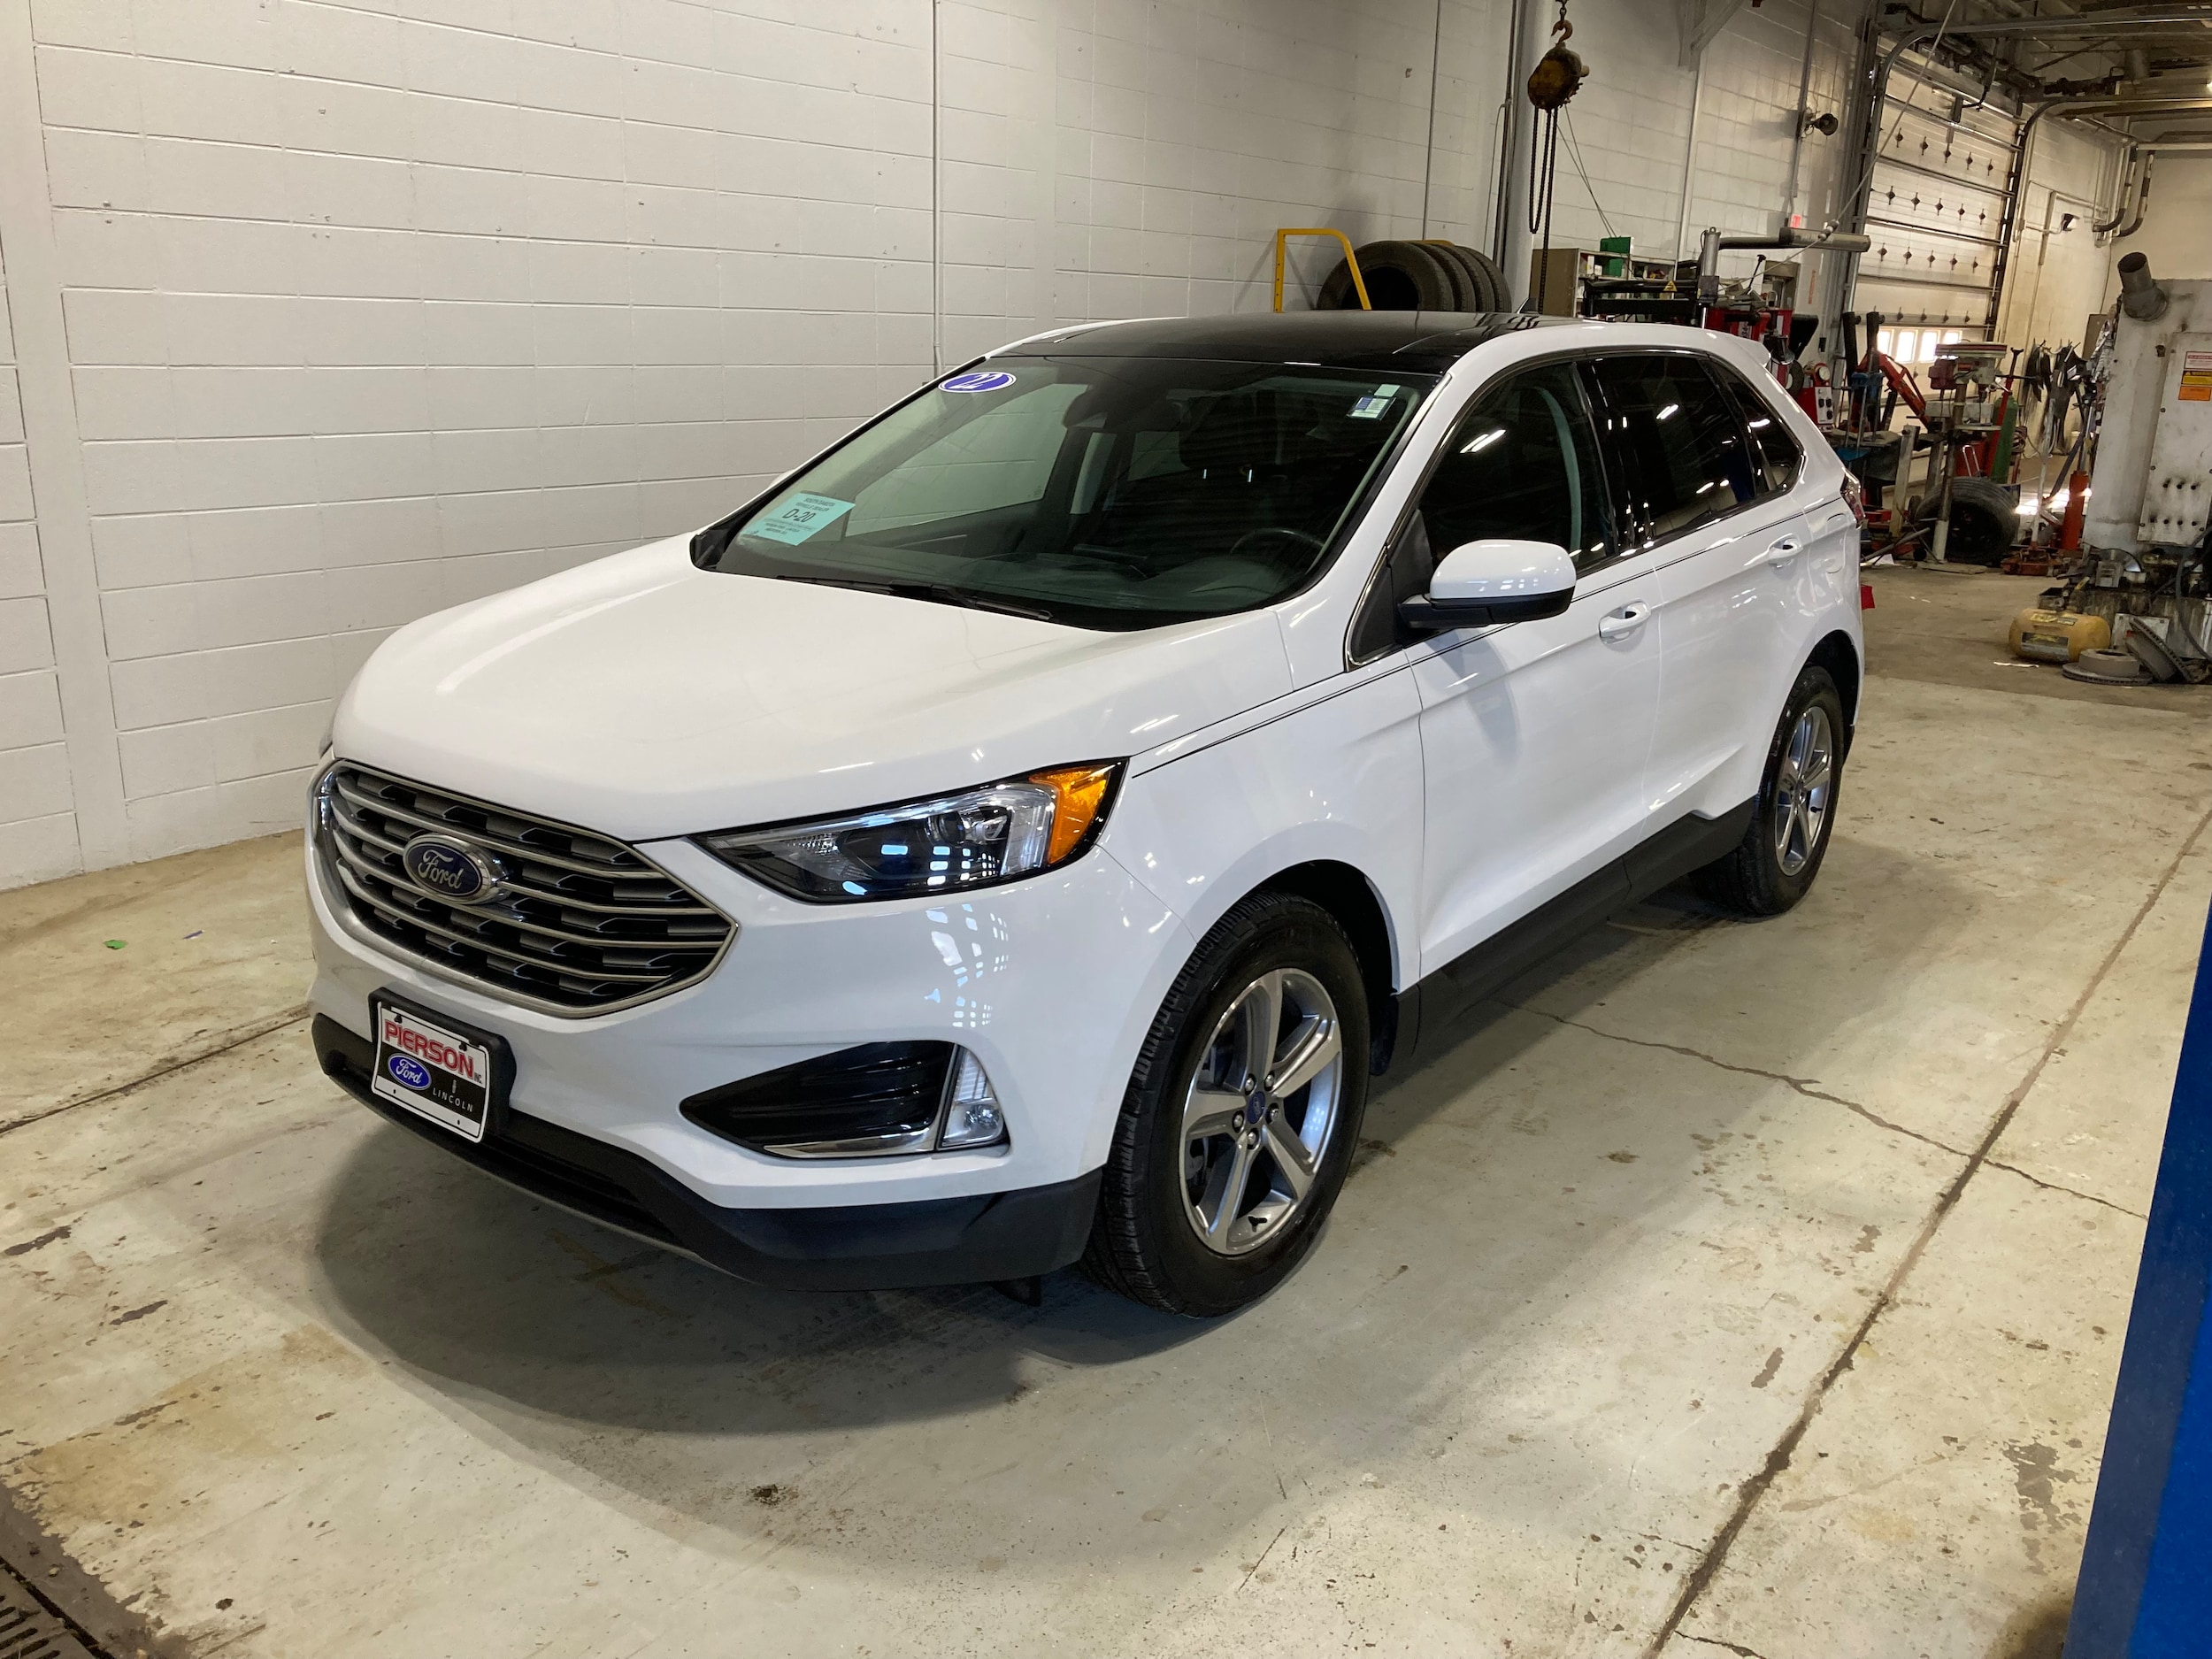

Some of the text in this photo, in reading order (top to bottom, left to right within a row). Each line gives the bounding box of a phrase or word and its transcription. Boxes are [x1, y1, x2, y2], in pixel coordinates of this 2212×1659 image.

[782, 508, 816, 523] D-20
[418, 849, 465, 889] Ford
[385, 1019, 474, 1079] PIERSON
[396, 1058, 423, 1085] Ford
[433, 1087, 473, 1113] LINCOLN
